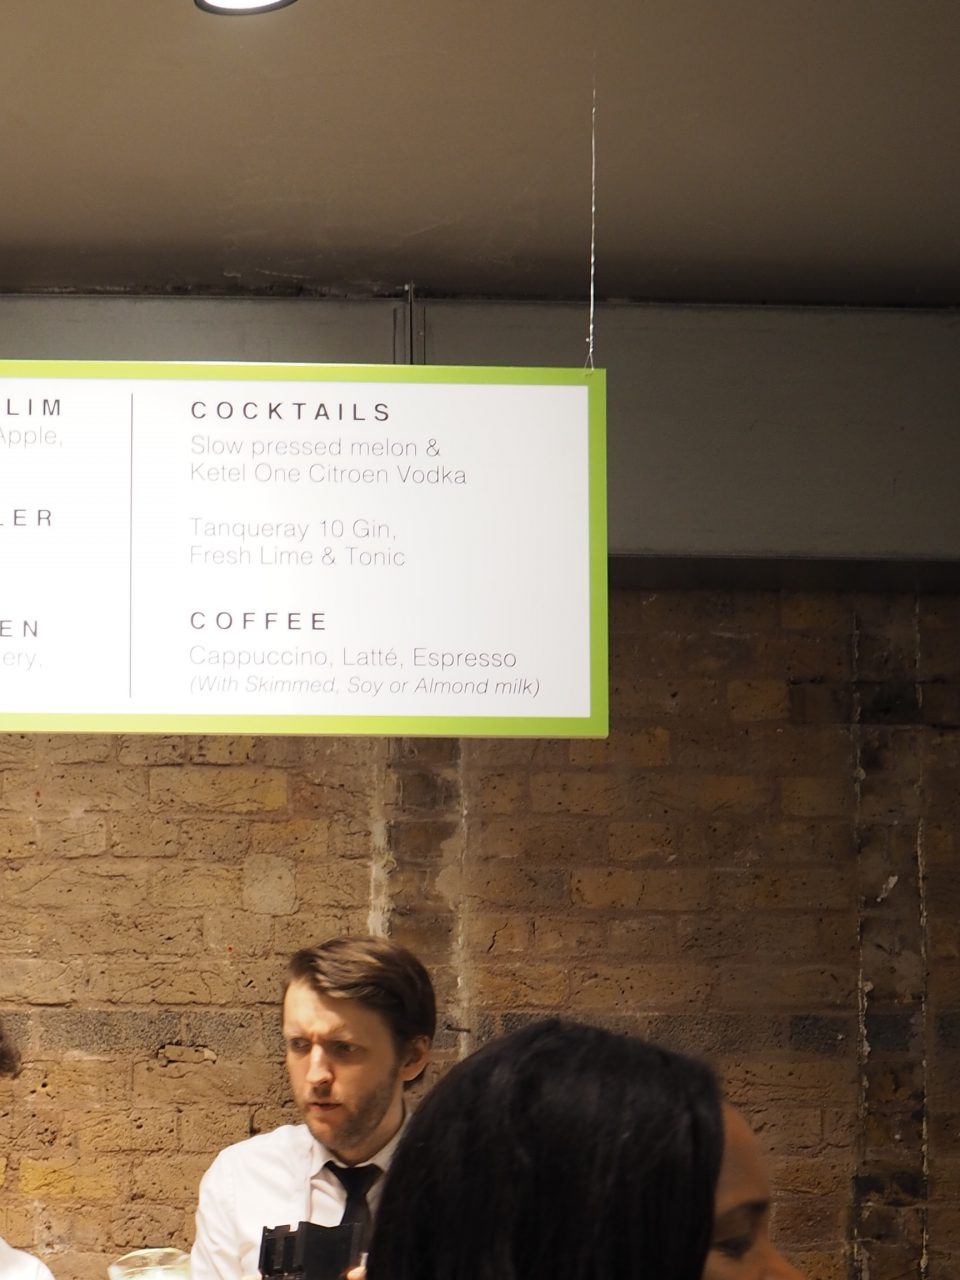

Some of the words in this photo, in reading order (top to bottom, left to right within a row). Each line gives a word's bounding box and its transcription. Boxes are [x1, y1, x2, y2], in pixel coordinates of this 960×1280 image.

[191, 401, 389, 421] COCKTAILS
[191, 434, 244, 456] Slow
[251, 437, 342, 460] pressed
[351, 437, 417, 458] melon
[426, 439, 440, 457] &
[191, 462, 245, 482] Ketel
[255, 462, 300, 483] One
[309, 463, 388, 484] Citroen
[397, 464, 467, 485] Vodka
[190, 517, 311, 543] Tanqueray
[320, 520, 344, 539] 10
[352, 519, 395, 541] Gin,
[190, 545, 251, 565] Fresh
[260, 546, 313, 567] Lime
[321, 546, 336, 566] &
[344, 545, 406, 568] Tonic
[190, 612, 325, 630] COFFEE
[189, 645, 333, 669] Cappuccino,
[344, 647, 403, 669] Latté,
[414, 648, 516, 672] Espresso
[190, 675, 238, 695] (With
[345, 675, 384, 697] Soy
[389, 680, 408, 694] or
[414, 677, 490, 694] Almond
[495, 678, 539, 698] milk)
